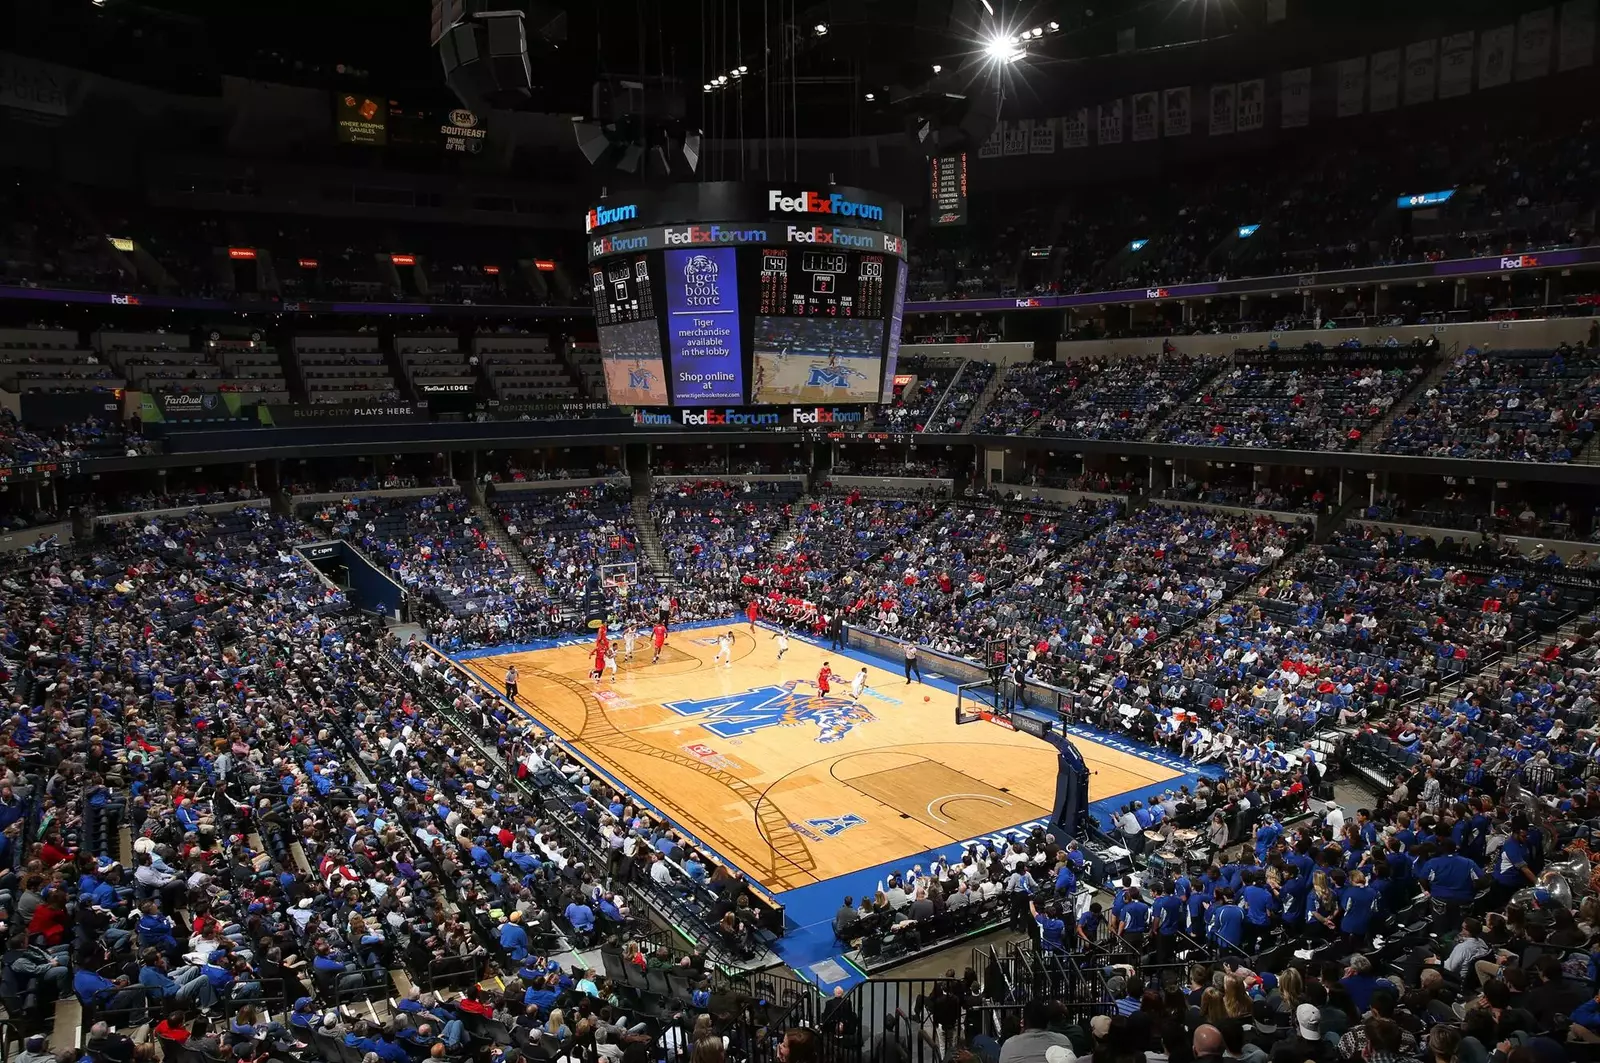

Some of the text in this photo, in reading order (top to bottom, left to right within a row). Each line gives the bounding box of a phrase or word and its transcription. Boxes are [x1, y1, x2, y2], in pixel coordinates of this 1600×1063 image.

[455, 112, 471, 121] FOX
[340, 120, 385, 130] WHERE MEMPHIS
[440, 125, 487, 139] SOUTHEAST
[447, 137, 466, 145] HOME
[455, 144, 466, 152] THE
[768, 189, 883, 221] FedExForum
[664, 224, 767, 245] FedExForum
[787, 226, 873, 247] FedExForum
[593, 235, 648, 256] FedExForum
[770, 258, 784, 269] 44
[1501, 256, 1538, 269] FedEx
[866, 263, 879, 275] 60
[686, 273, 718, 287] tiger
[685, 283, 719, 296] book
[1147, 289, 1170, 298] FedEx
[111, 294, 140, 306] FedEx
[687, 296, 720, 306] store
[1016, 298, 1041, 307] FedEx
[693, 318, 714, 328] Tiger
[678, 327, 731, 337] merchandise
[687, 337, 723, 346] available
[681, 347, 730, 356] in the lobby
[680, 371, 735, 382] Shop online
[702, 381, 713, 389] at
[164, 394, 203, 405] FanDuel
[562, 402, 584, 410] WINS
[586, 402, 609, 410] HERE.
[293, 409, 325, 417] BLUFF
[354, 407, 384, 416] PLAYS
[386, 407, 414, 415] HERE.
[682, 409, 779, 425] FedExForum
[792, 407, 861, 423] FedExForum
[1020, 718, 1040, 732] Telogis
